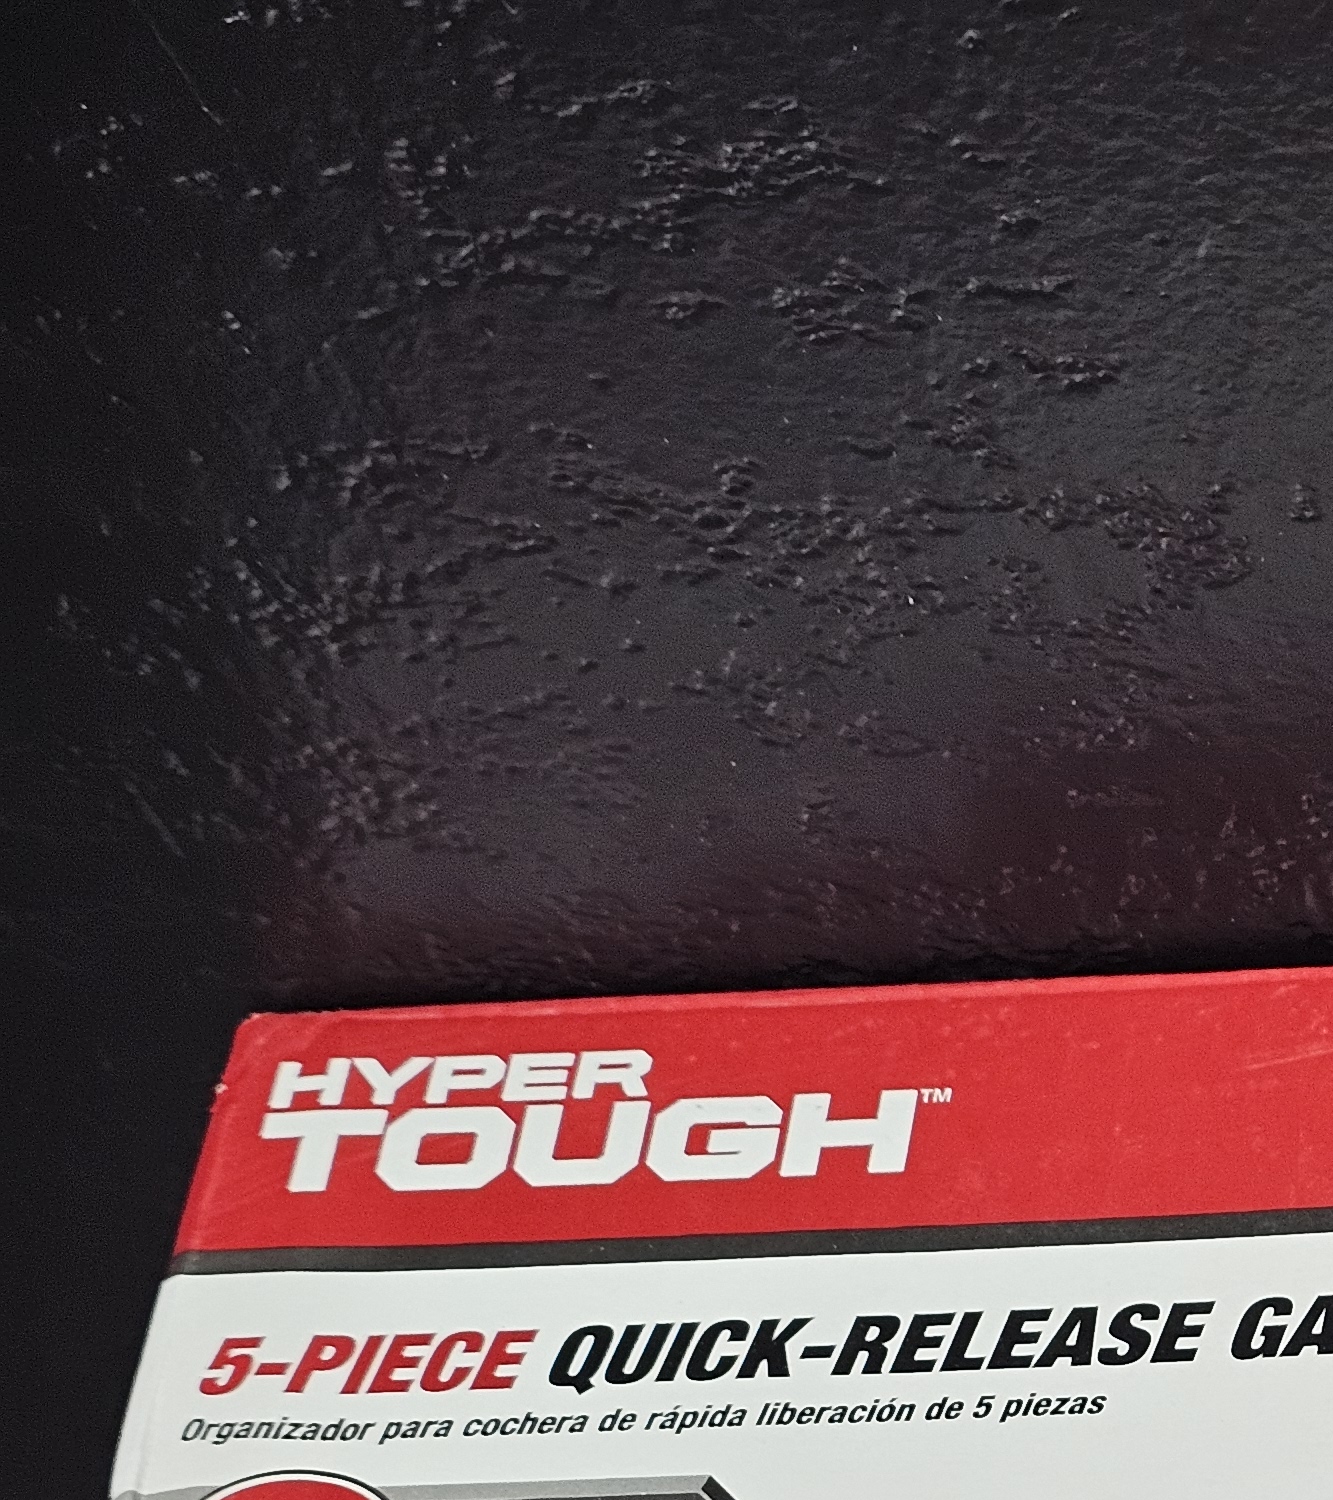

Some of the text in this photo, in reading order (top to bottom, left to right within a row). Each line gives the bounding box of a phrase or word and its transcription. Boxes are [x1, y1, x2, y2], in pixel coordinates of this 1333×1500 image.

[268, 1050, 653, 1109] HYPER
[260, 1089, 918, 1192] TOUGH
[199, 1330, 538, 1395] 5-PIECE
[549, 1301, 1215, 1395] QUICK-RELEASE
[181, 1393, 1107, 1445] Organizador para cochera de rápida liberación de 5 piezas
